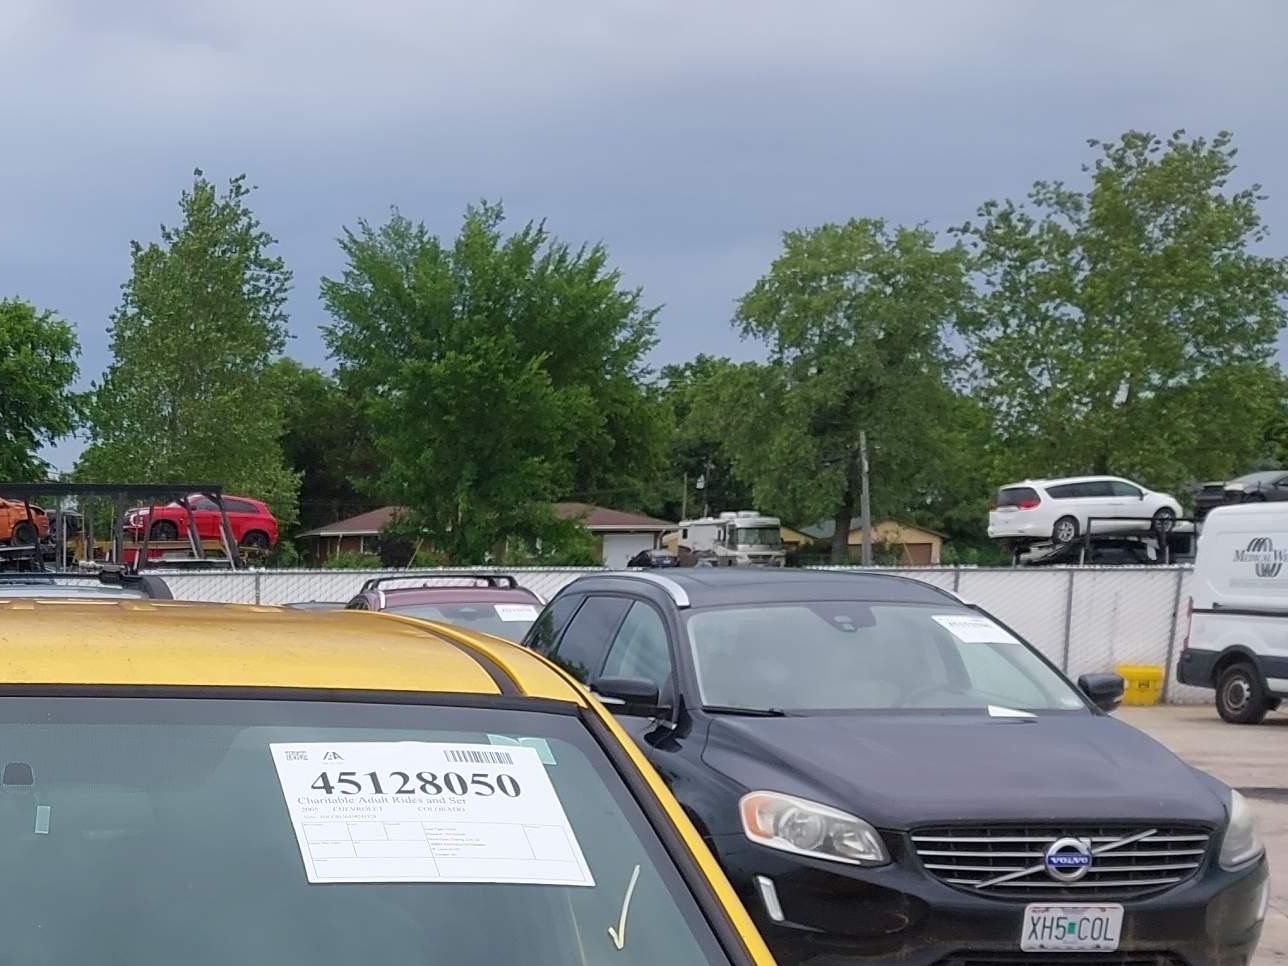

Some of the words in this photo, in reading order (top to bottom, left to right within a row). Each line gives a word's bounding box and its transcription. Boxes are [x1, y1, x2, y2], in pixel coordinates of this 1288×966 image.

[311, 771, 522, 798] 45128050
[297, 796, 355, 805] Charitable
[358, 796, 390, 804] Adult
[392, 796, 424, 804] Rides
[426, 796, 446, 805] and
[1028, 916, 1068, 941] XH5
